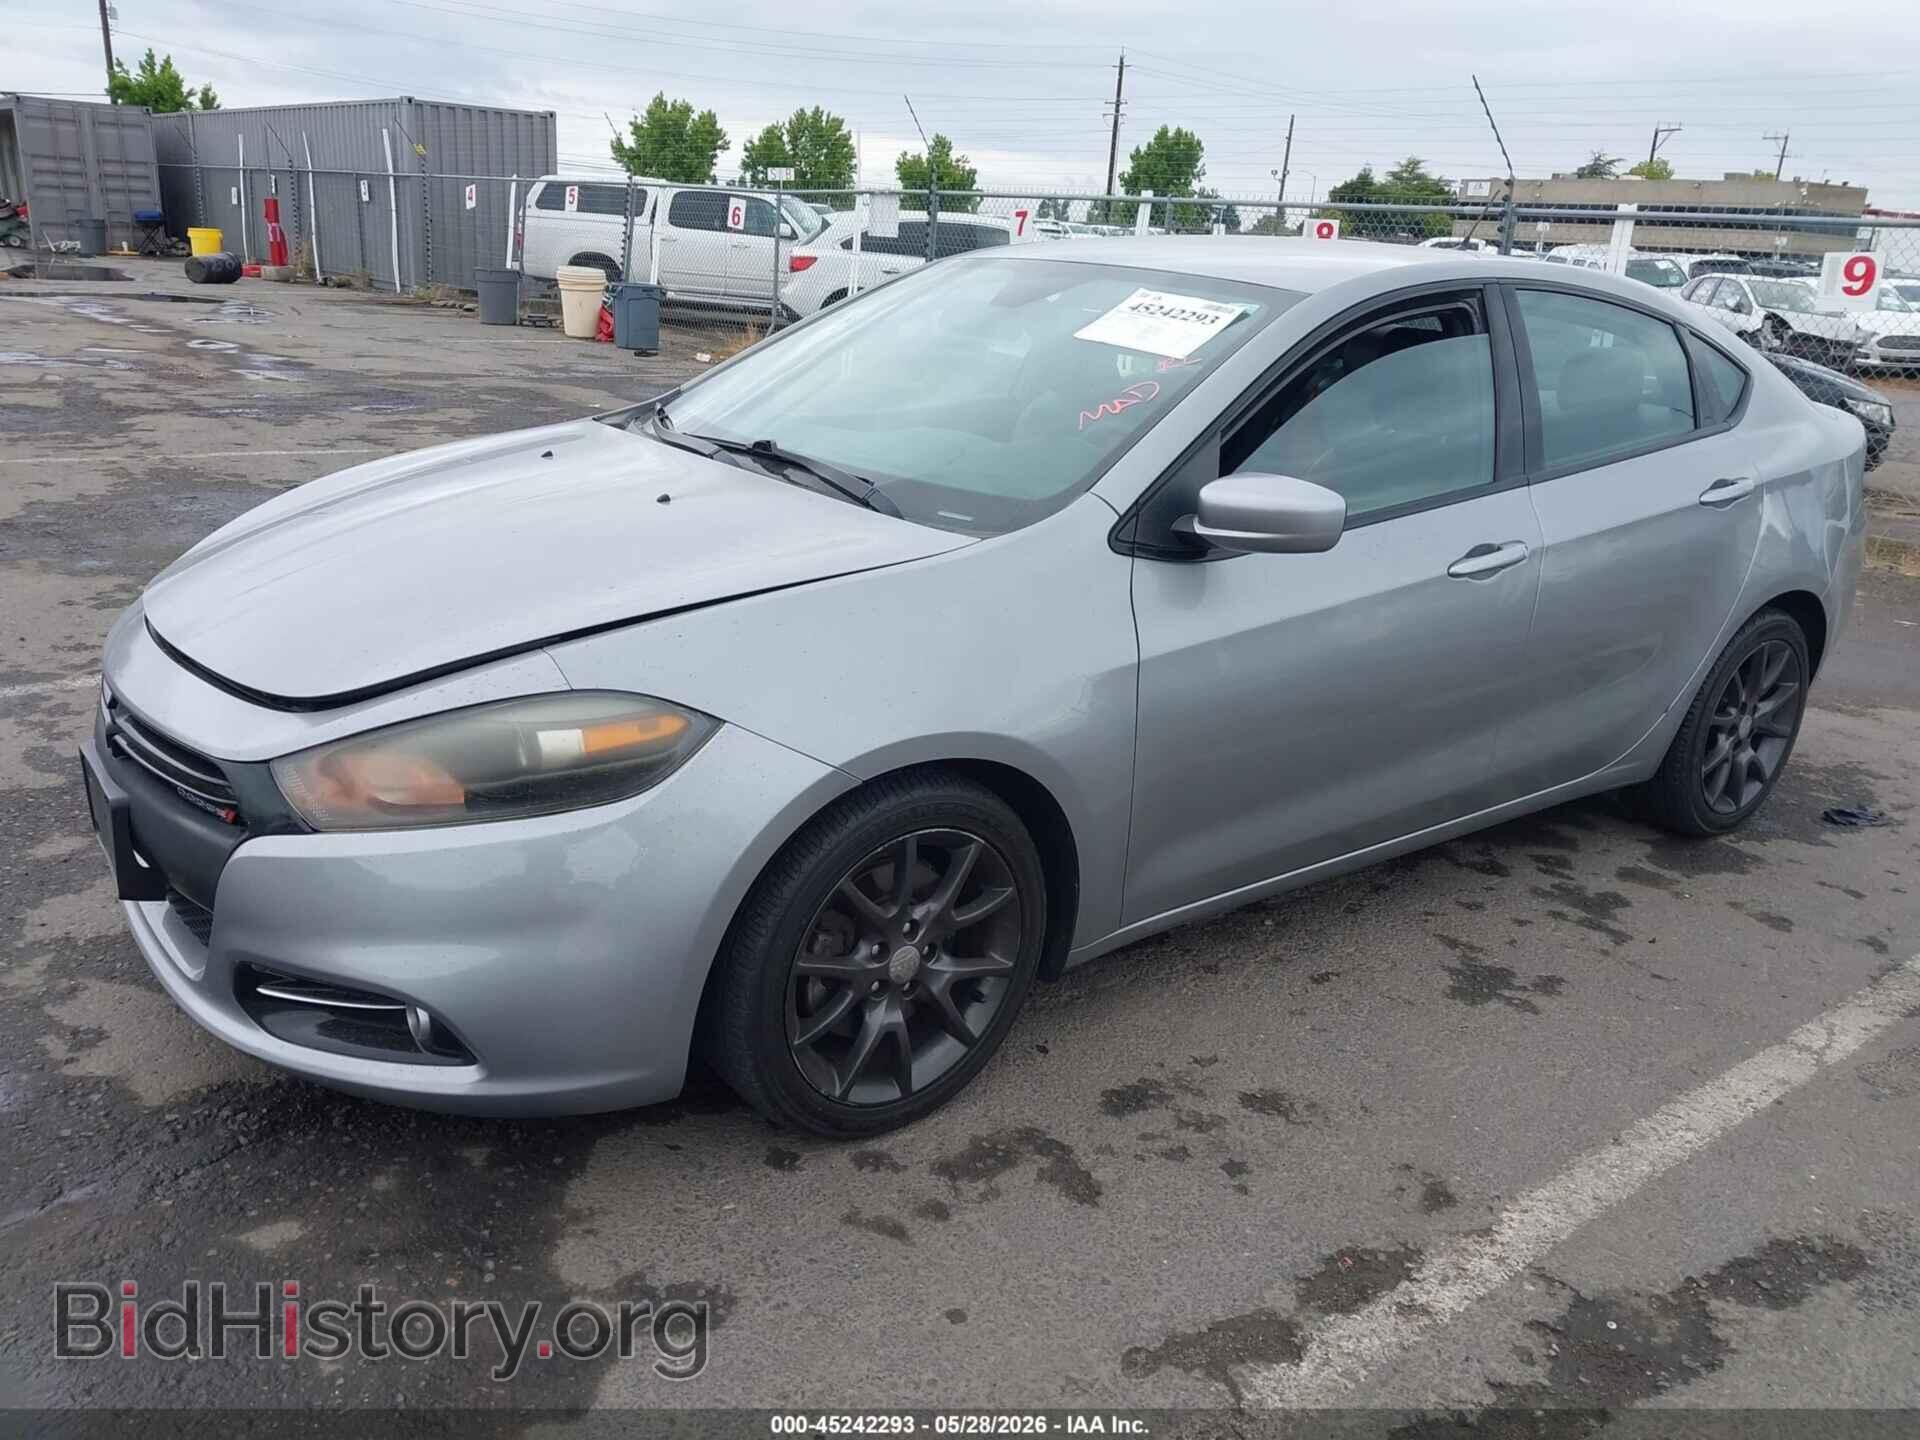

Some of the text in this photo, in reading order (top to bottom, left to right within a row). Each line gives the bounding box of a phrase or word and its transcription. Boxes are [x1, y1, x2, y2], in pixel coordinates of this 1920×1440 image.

[467, 187, 474, 203] 4
[568, 188, 576, 205] 5
[731, 206, 742, 226] 6
[1015, 209, 1028, 237] 7
[1841, 255, 1876, 296] 9
[1128, 302, 1221, 325] 45242293
